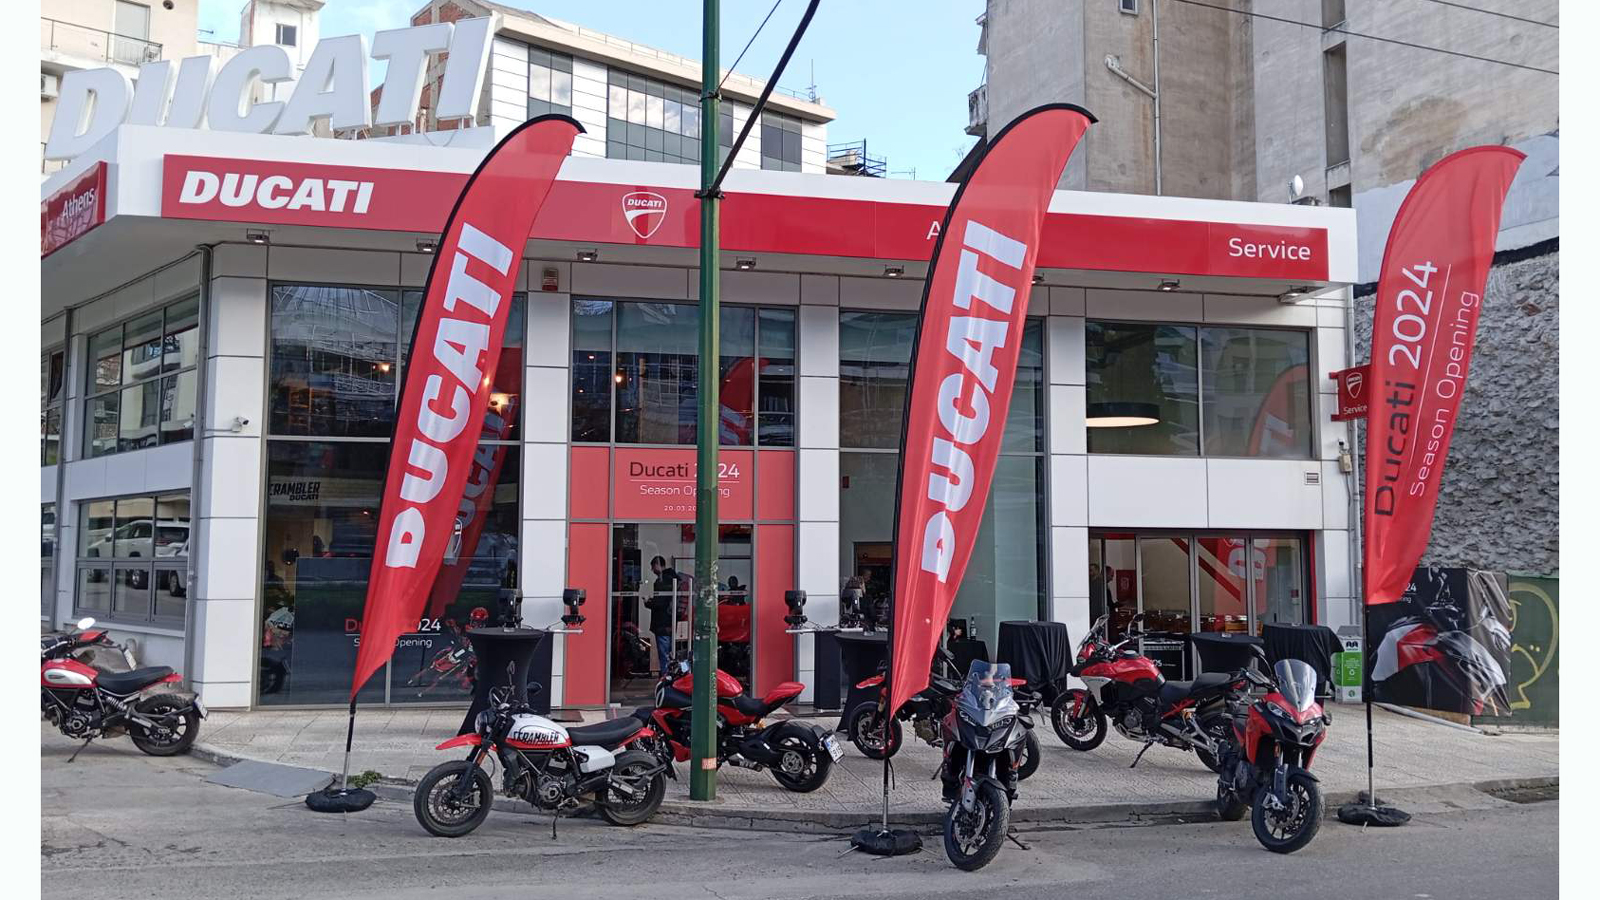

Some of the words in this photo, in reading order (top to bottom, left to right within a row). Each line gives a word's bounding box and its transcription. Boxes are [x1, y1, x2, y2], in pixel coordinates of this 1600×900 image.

[44, 15, 500, 160] DUCATI
[62, 188, 95, 219] Athens
[179, 170, 375, 215] DUCATI
[627, 198, 662, 208] DUCATI
[1229, 237, 1311, 260] Service
[1388, 261, 1438, 370] 2024
[385, 222, 514, 569] DUCATI
[921, 219, 1028, 584] DUCATI
[1343, 404, 1368, 415] Service
[1410, 408, 1450, 497] Season
[1436, 291, 1479, 399] Opening
[1374, 381, 1416, 516] Ducati
[630, 461, 689, 477] Ducati
[694, 463, 740, 478] 24
[640, 485, 680, 495] Season
[513, 730, 559, 745] SCRAMBLER
